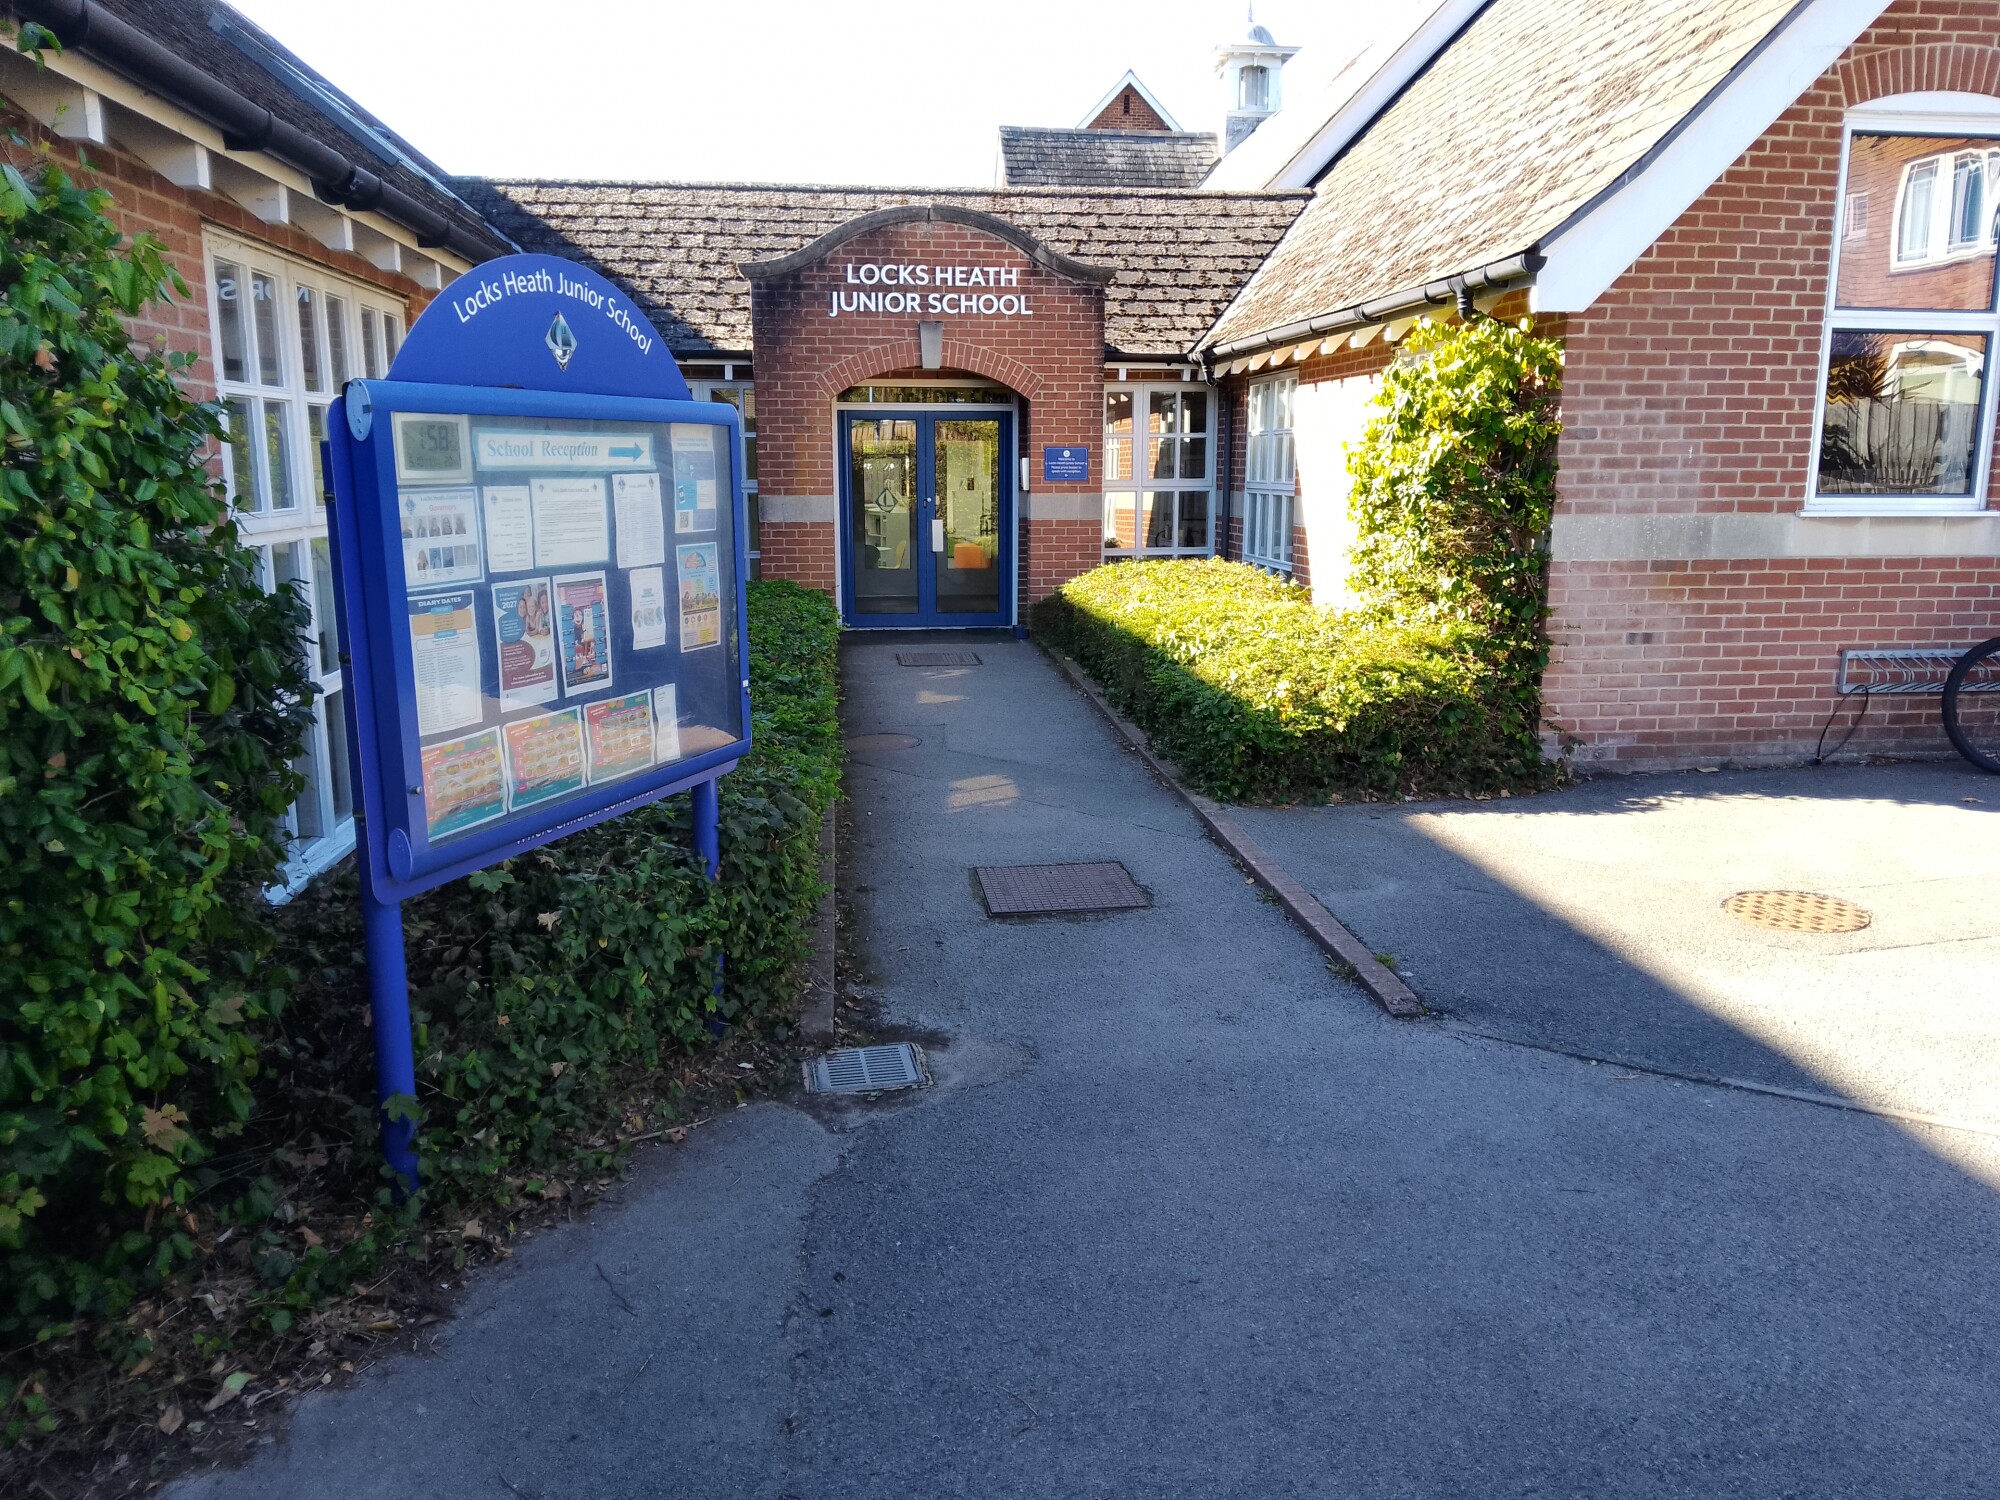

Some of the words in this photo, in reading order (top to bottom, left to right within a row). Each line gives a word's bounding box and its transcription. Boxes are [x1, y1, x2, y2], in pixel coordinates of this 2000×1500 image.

[847, 263, 929, 286] LOCKS
[935, 266, 1018, 287] HEATH
[453, 280, 503, 323] Locks
[502, 268, 553, 296] Heath
[556, 272, 605, 310] Junior
[605, 297, 653, 355] School
[829, 291, 922, 317] JUNIOR
[927, 293, 1033, 315] SCHOOL
[487, 440, 534, 457] School
[541, 441, 599, 461] Reception
[441, 597, 462, 605] DATES
